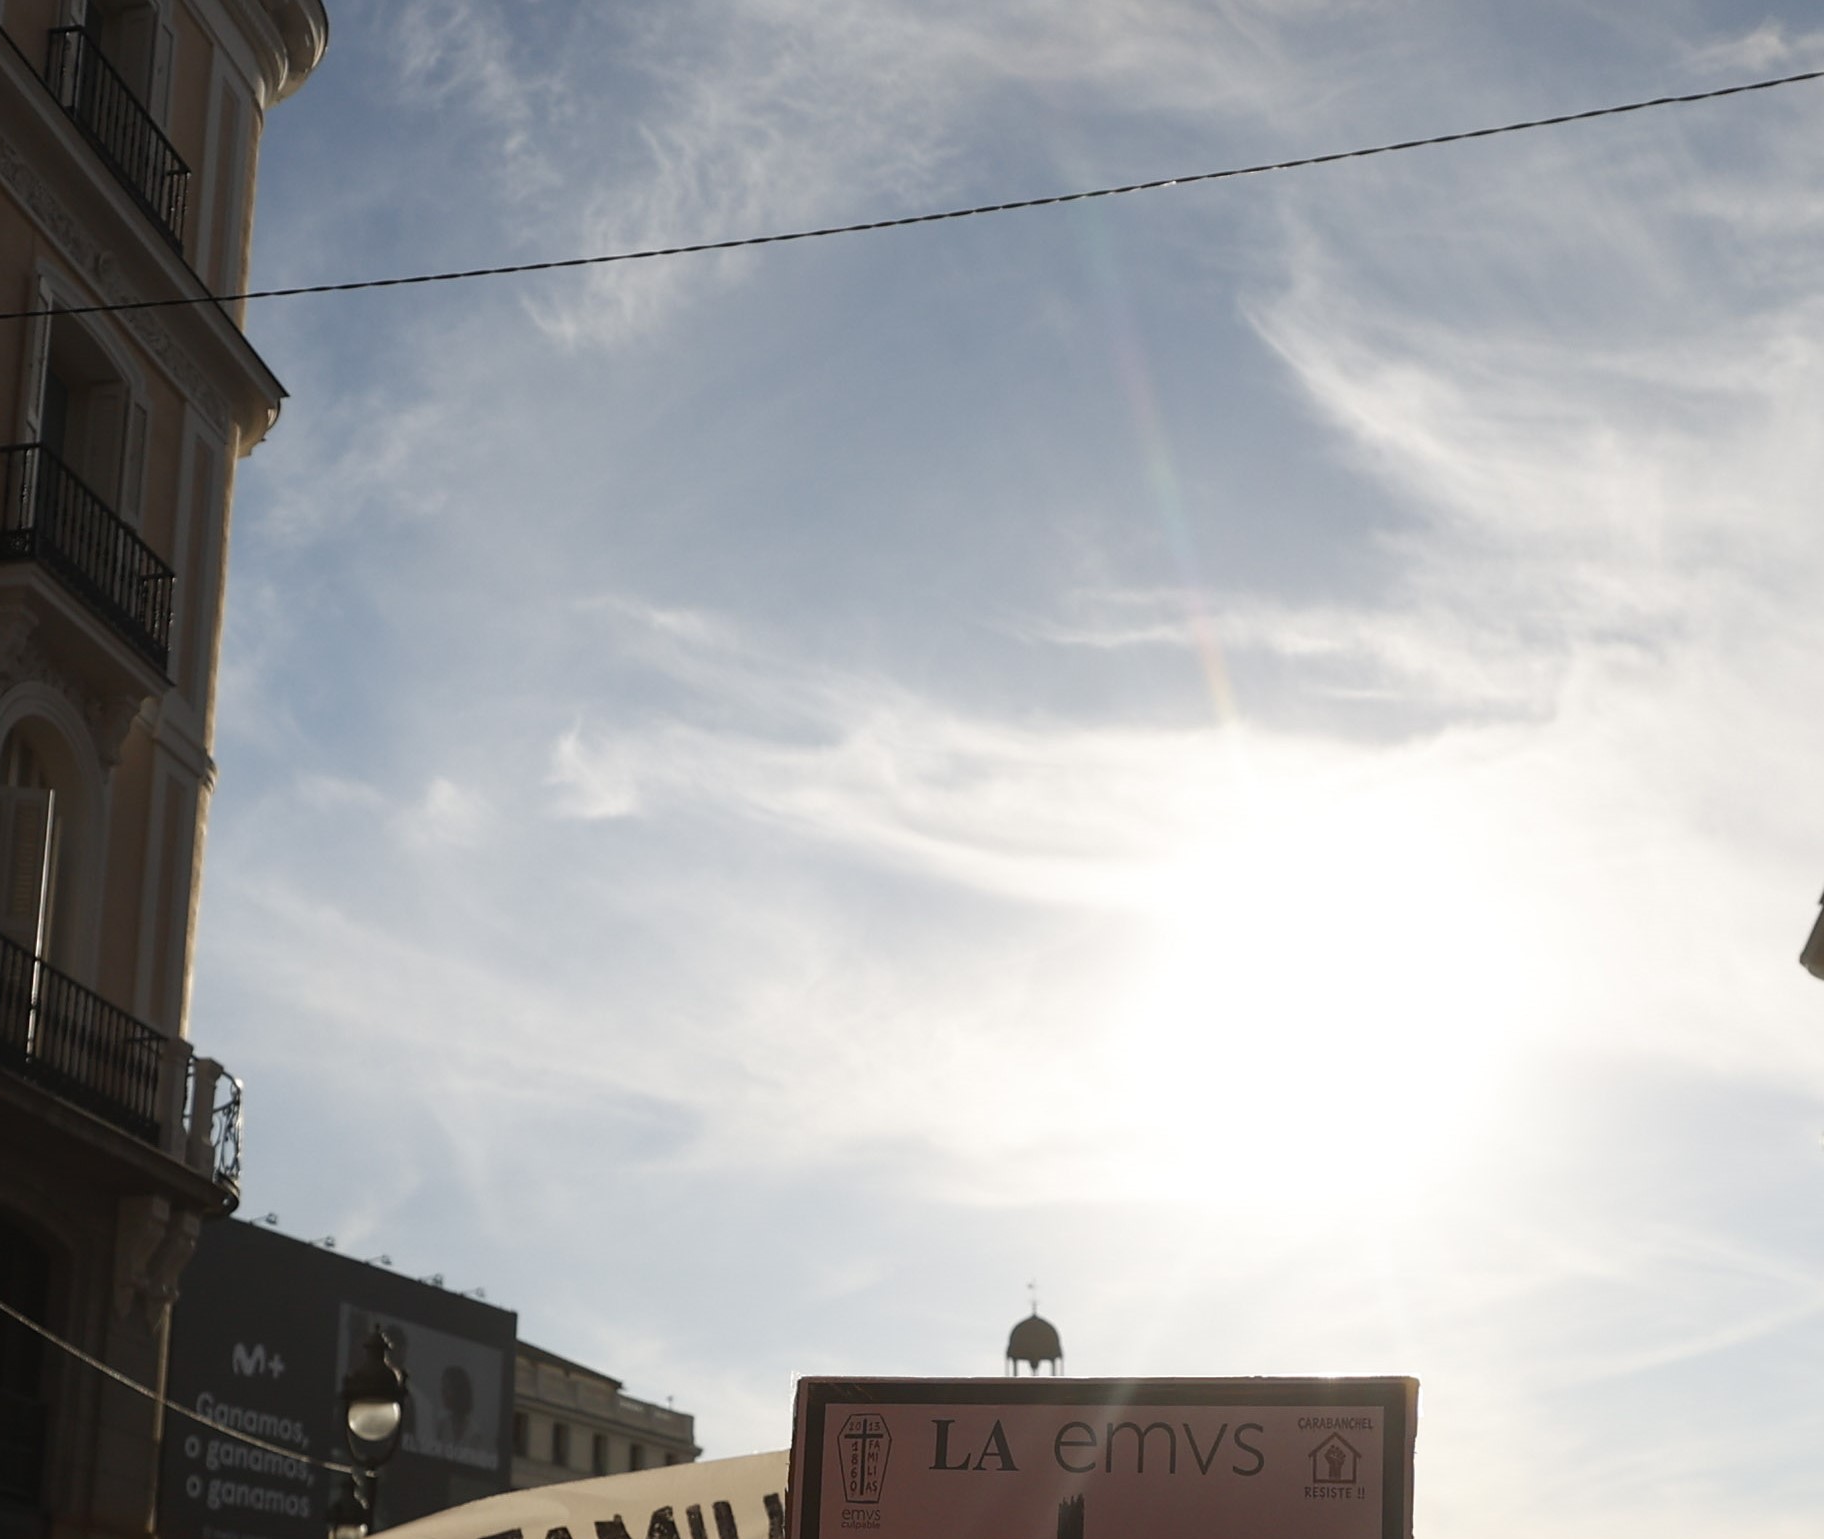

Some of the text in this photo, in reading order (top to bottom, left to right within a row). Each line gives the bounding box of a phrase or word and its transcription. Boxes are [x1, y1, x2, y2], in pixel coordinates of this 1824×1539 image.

[195, 1391, 310, 1449] Ganamos,
[1297, 1417, 1374, 1430] CARABANCHEL
[184, 1434, 202, 1459] o
[929, 1419, 1265, 1477] LA emvs
[186, 1474, 311, 1518] o ganamos
[1304, 1486, 1352, 1499] RESISTE
[841, 1507, 881, 1521] emvs
